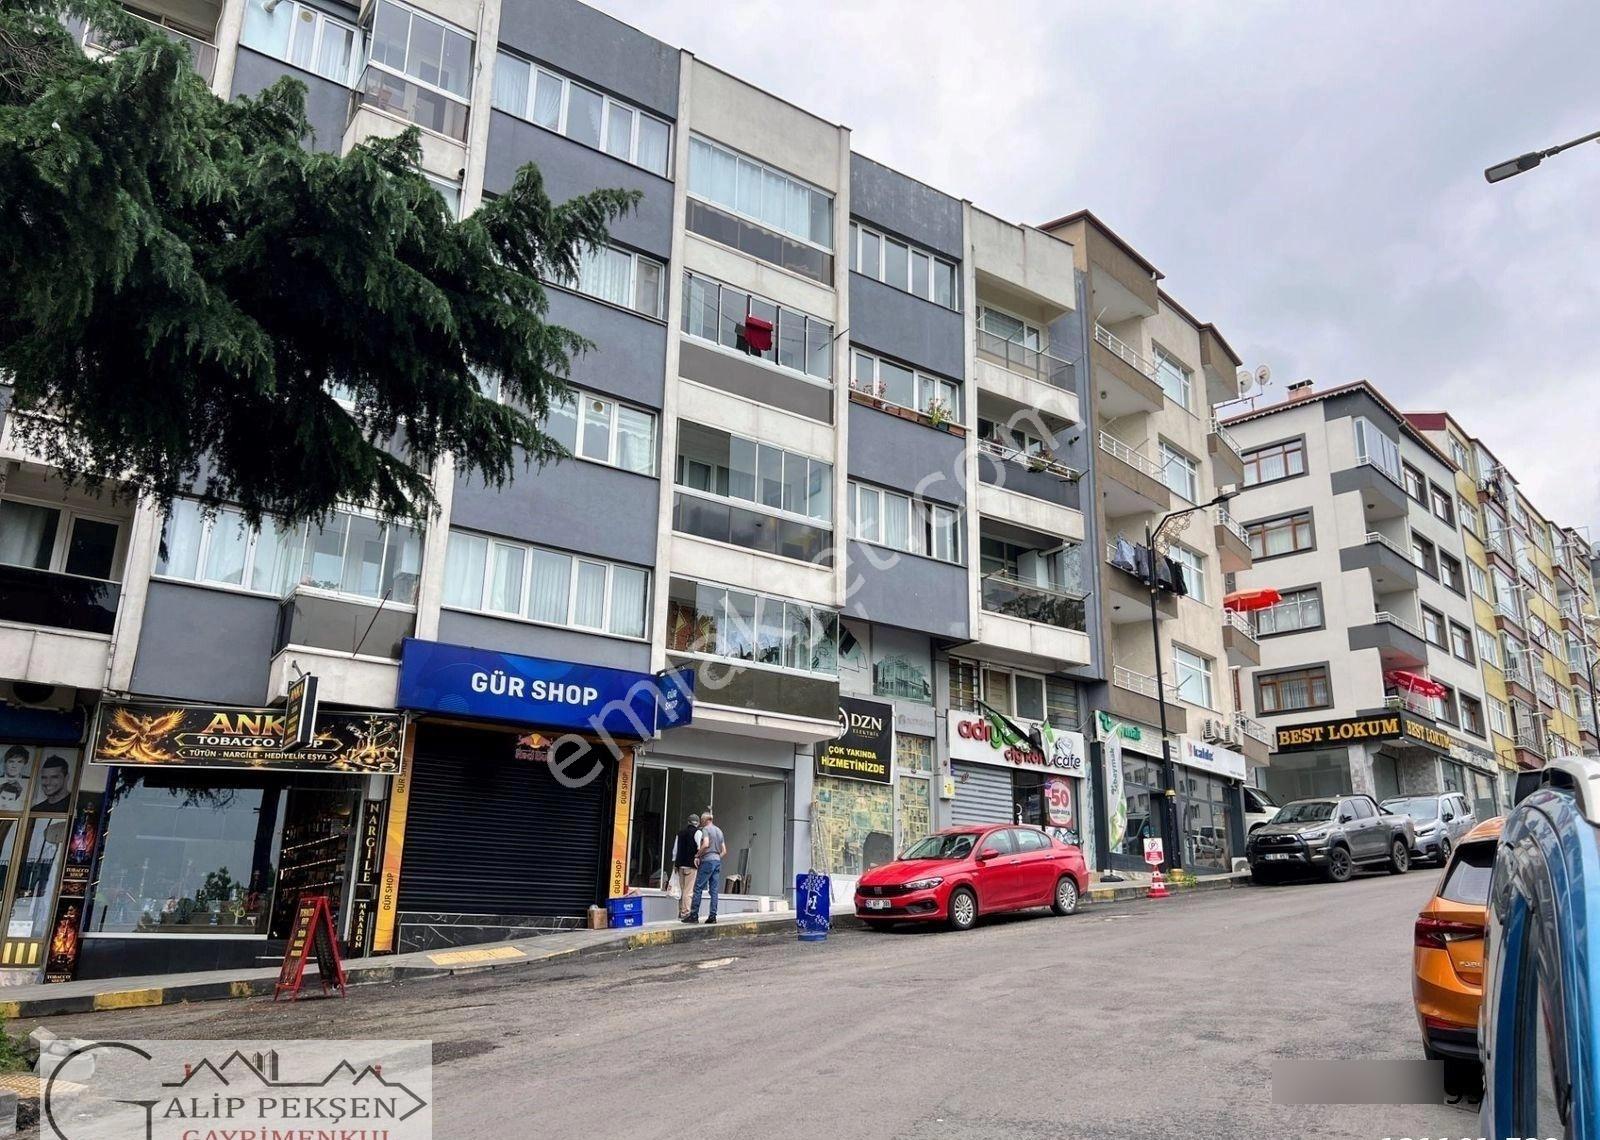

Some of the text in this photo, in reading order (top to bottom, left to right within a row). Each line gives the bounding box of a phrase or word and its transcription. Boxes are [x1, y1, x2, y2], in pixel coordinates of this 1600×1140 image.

[471, 670, 598, 706] GÜR SHOP
[202, 712, 287, 736] ANK
[851, 713, 882, 731] DZN
[1279, 719, 1399, 746] BEST LOKUM
[1406, 720, 1451, 749] BEST LOKUM
[190, 749, 327, 762] TÜTÜN NARGİLE HEDİYELİK EŞYA
[197, 736, 275, 748] TOBACCO
[829, 746, 877, 760] ÇOK YAKINDA
[821, 756, 885, 775] HİZMETİNİZDE
[363, 803, 379, 883] NARGİLE
[613, 860, 623, 895] GÜR SHOP
[383, 872, 395, 911] GÜR SHOP
[355, 902, 367, 949] MAKARON
